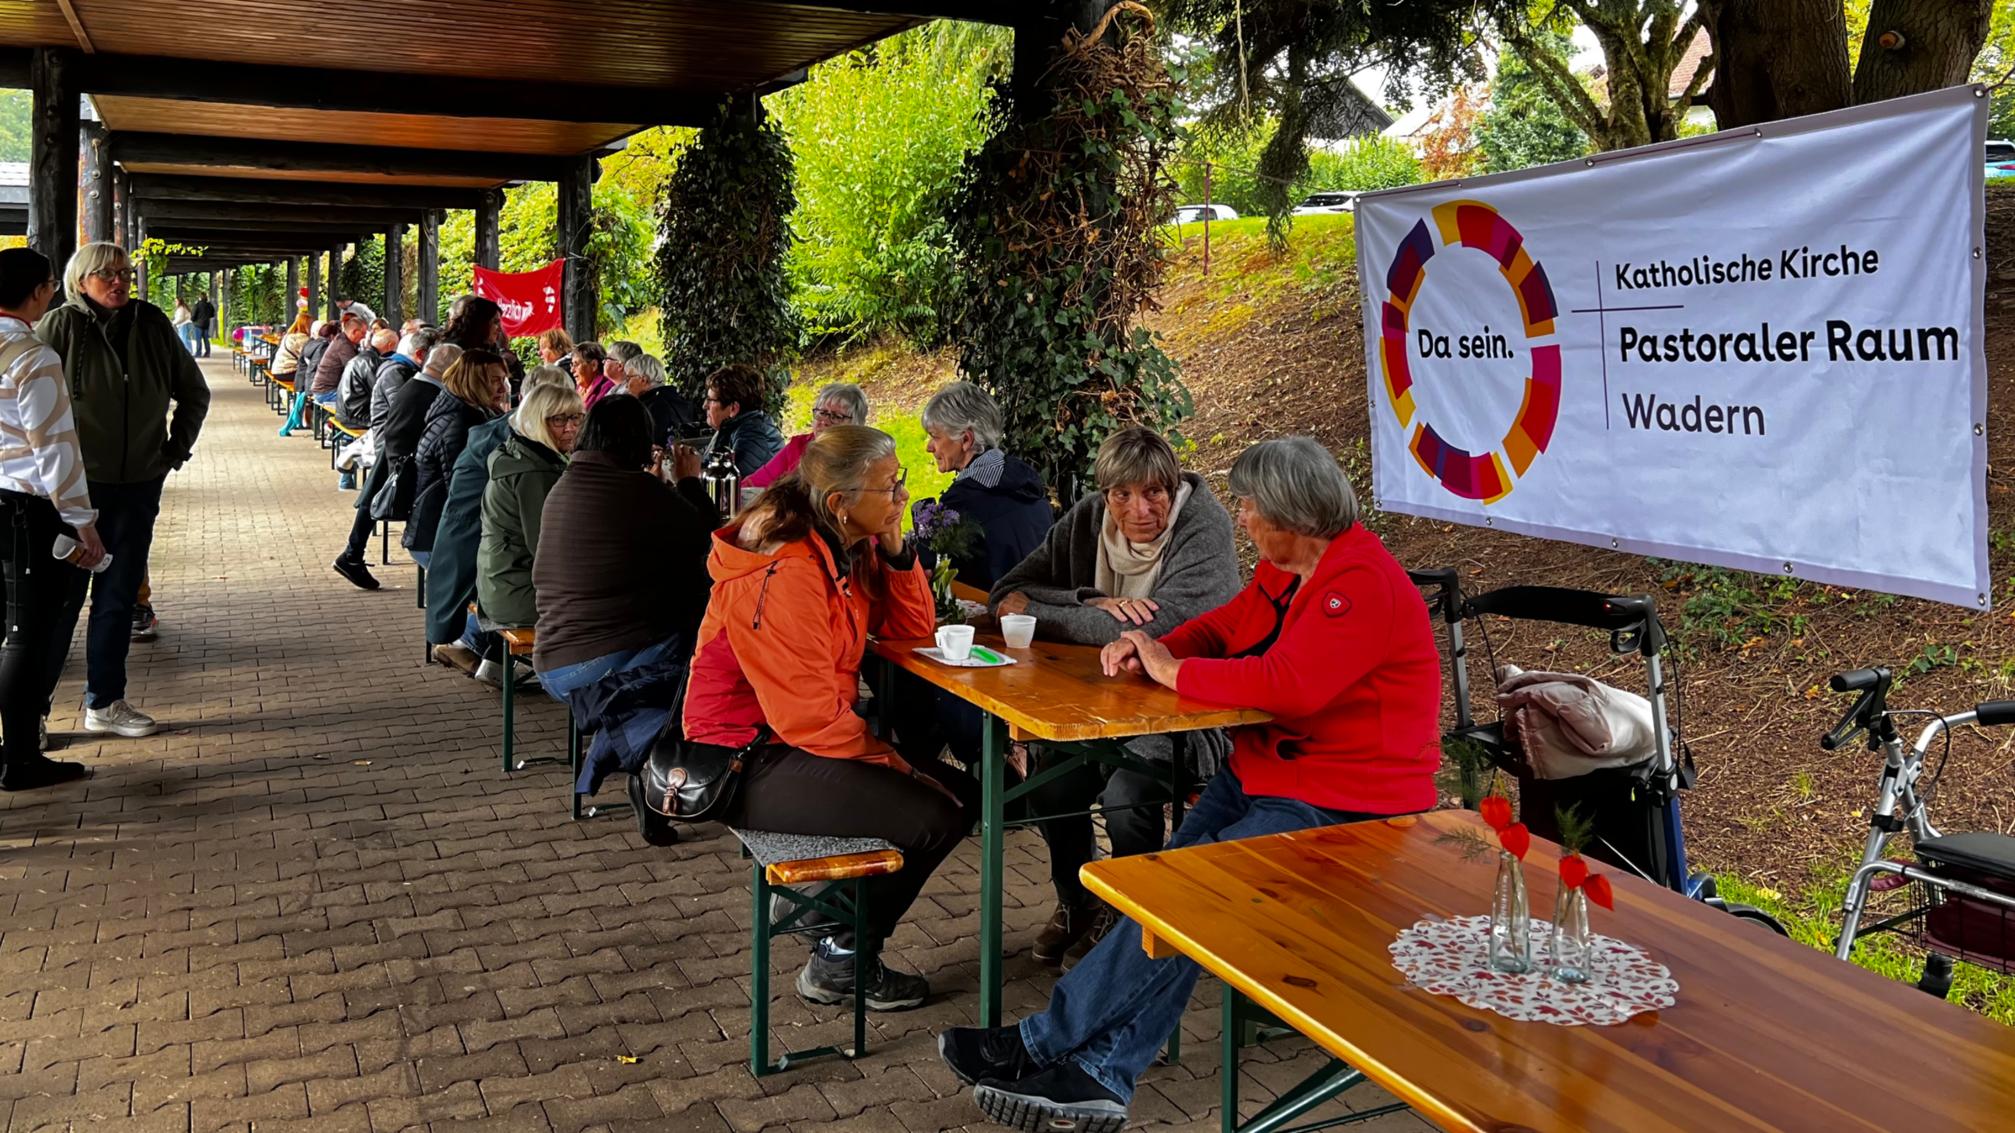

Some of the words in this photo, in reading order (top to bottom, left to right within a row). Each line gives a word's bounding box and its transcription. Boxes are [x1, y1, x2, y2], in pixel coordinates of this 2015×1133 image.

[1615, 253, 1772, 290] Katholische
[1780, 244, 1879, 280] Kirche
[1417, 328, 1452, 359] Da
[1458, 325, 1514, 359] sein.
[1620, 322, 1816, 363] Pastoraler
[1826, 319, 1959, 362] Raum
[1622, 392, 1765, 436] Wadern
